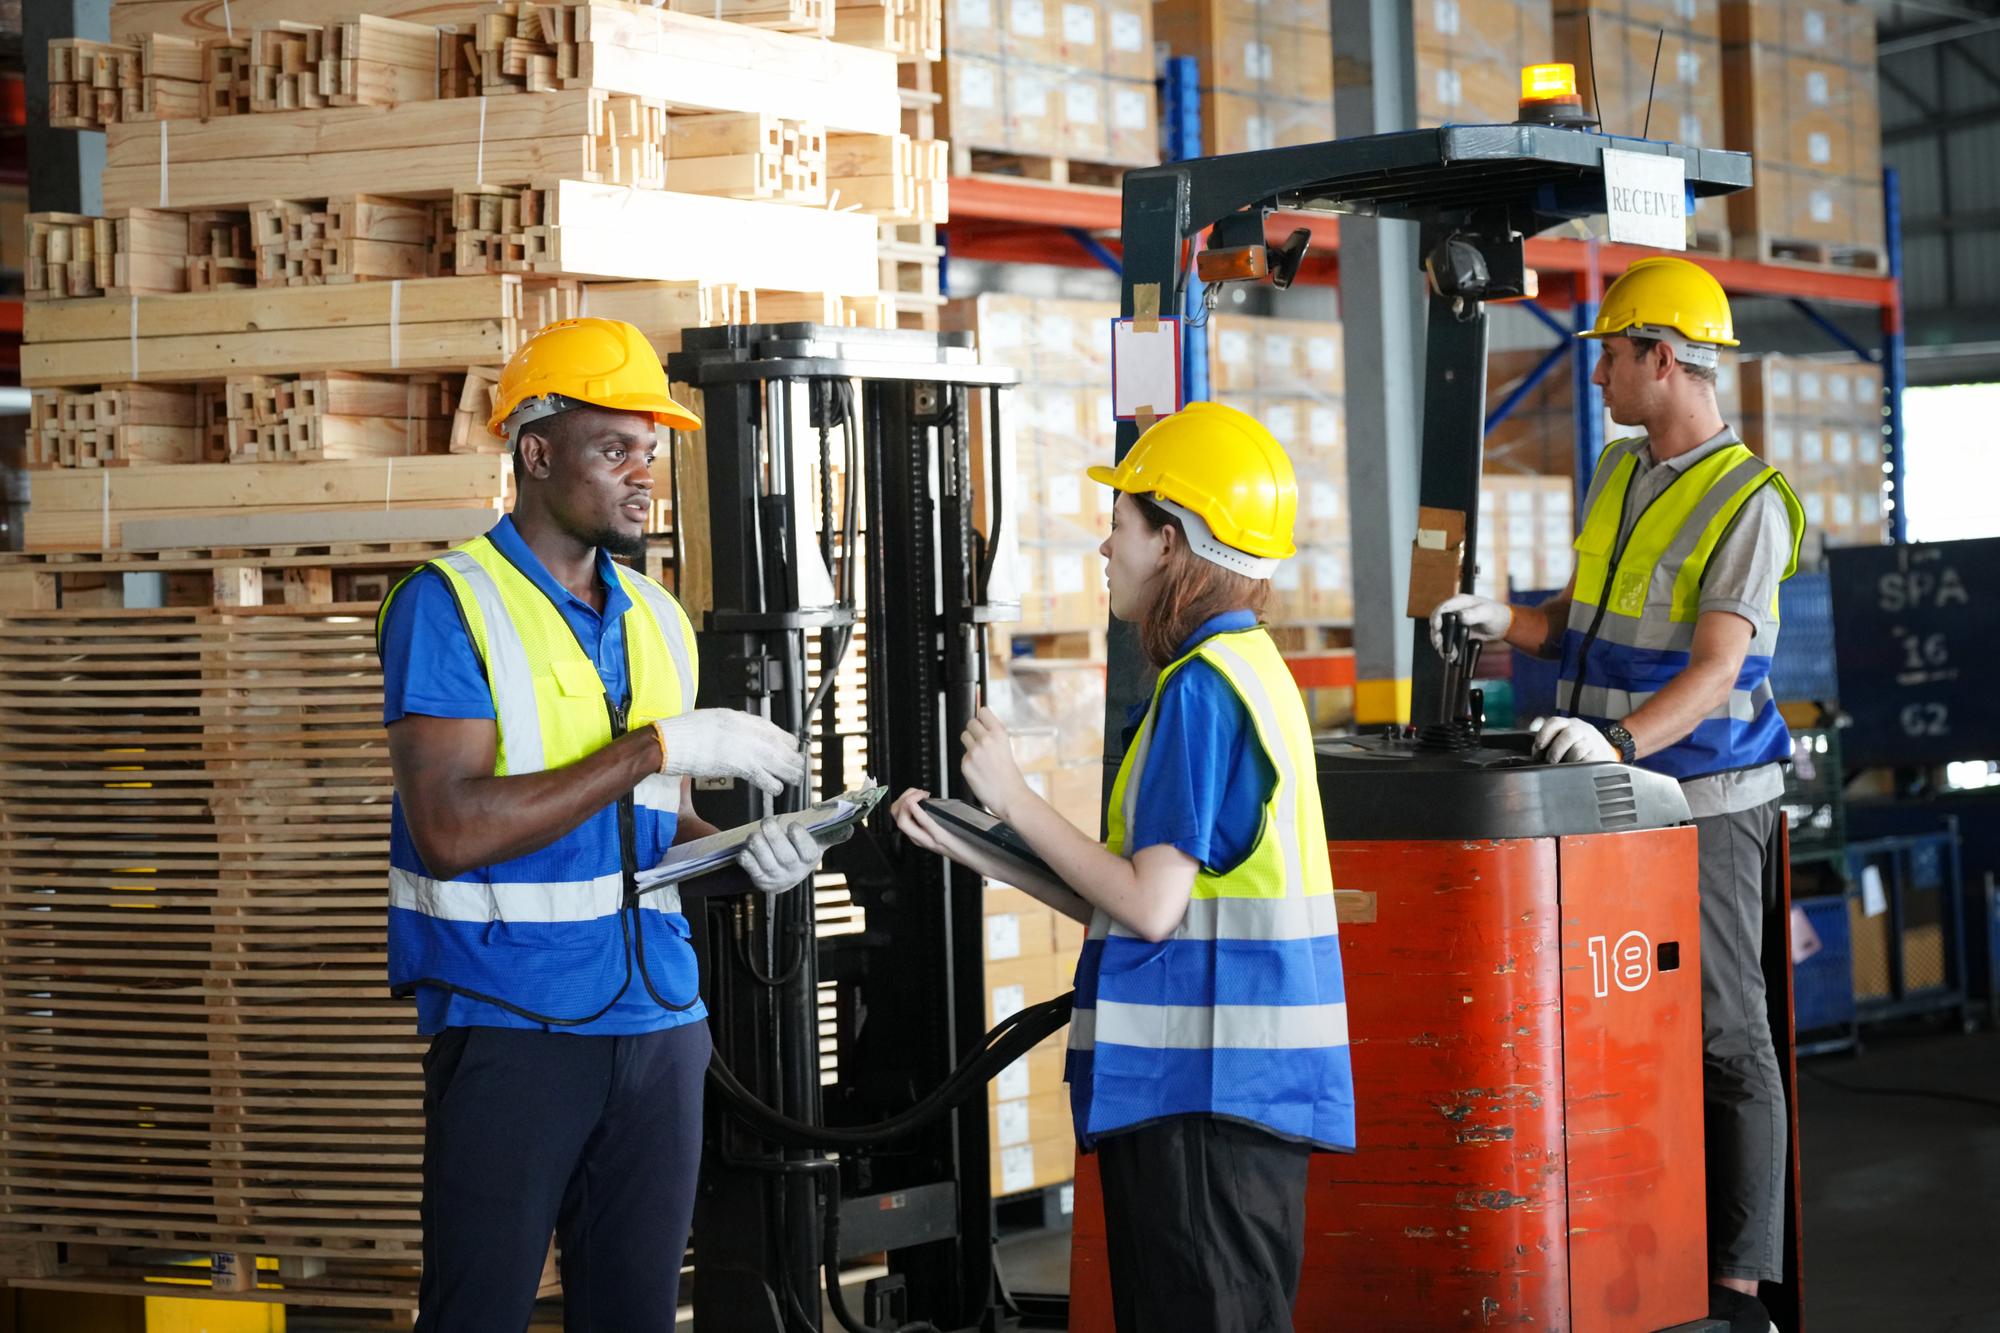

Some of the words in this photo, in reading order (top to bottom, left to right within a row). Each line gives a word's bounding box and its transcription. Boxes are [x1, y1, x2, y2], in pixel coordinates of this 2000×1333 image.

[1611, 185, 1681, 220] RECEIVE
[1878, 568, 1969, 612] SPA
[1902, 633, 1949, 669] 16
[1588, 930, 1651, 998] 18
